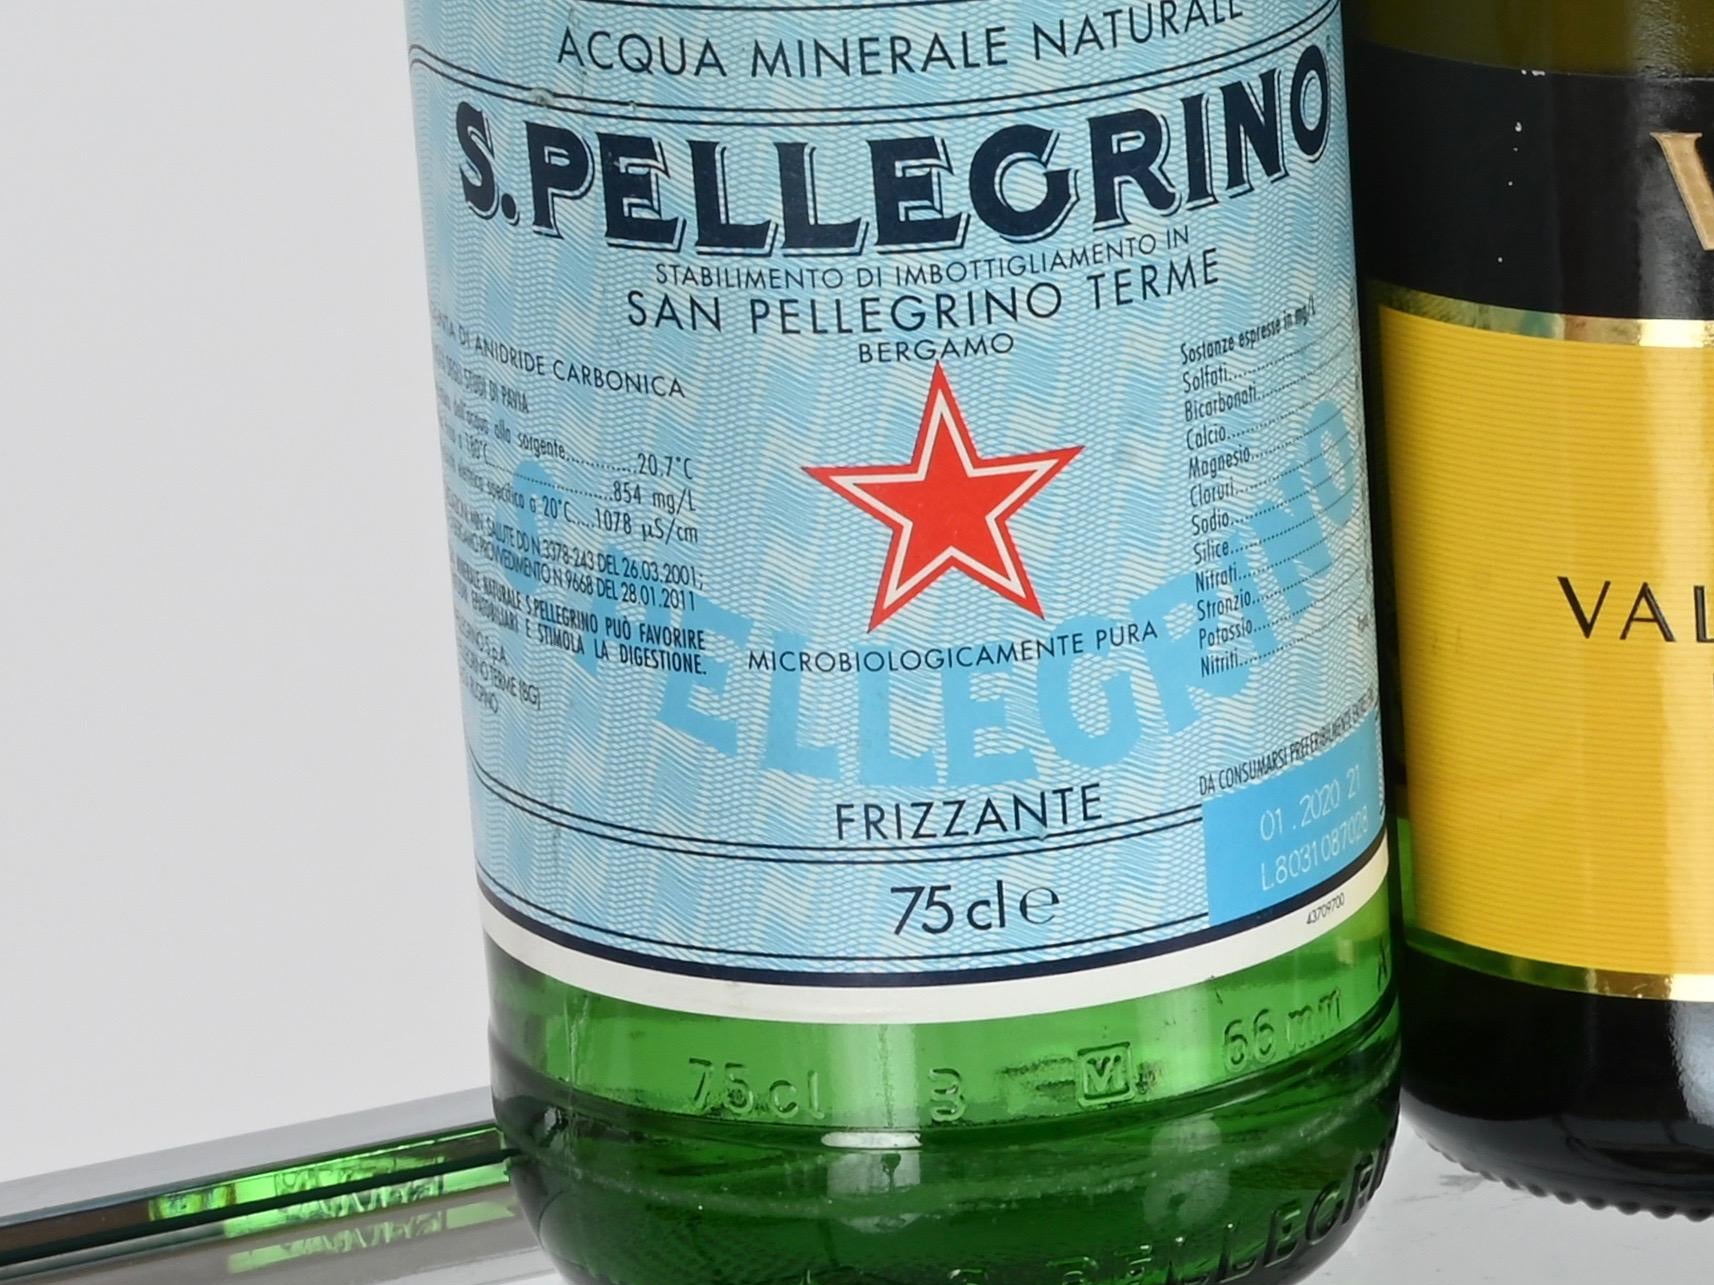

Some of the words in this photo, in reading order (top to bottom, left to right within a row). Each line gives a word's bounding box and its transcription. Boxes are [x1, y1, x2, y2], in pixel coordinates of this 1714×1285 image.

[557, 27, 727, 77] ACQUA
[751, 26, 1009, 78] MINERALE
[456, 44, 1332, 258] S.PELLEGRINO
[656, 263, 844, 290] STABILIMENTO
[858, 268, 882, 288] DI
[896, 234, 1157, 287] IMBOTTIGLIAMENTO
[1167, 226, 1190, 250] IN
[627, 290, 722, 333] SAN
[752, 281, 1063, 334] PELLEGRINO
[1087, 248, 1220, 309] TERME
[859, 333, 1015, 363] BERGAMO
[1180, 335, 1235, 365] Sostanze
[1238, 318, 1281, 349] espresse
[1283, 310, 1293, 330] in
[475, 336, 545, 376] ANIDRIDE
[553, 359, 686, 399] CARBONICA
[1183, 361, 1228, 394] Solfati
[1185, 380, 1258, 422] Bicarbonati
[1186, 423, 1227, 450] Calcio
[517, 432, 566, 459] sorgente
[638, 452, 693, 480] 20.7°C
[1189, 443, 1250, 479] Magnesio
[613, 480, 642, 505] 854
[652, 488, 696, 515] mg/L
[1189, 477, 1235, 508] Cloruri
[595, 507, 632, 535] 1078
[1191, 511, 1230, 536] Sodio
[597, 553, 619, 576] DEL
[1193, 537, 1230, 565] Silice
[565, 570, 593, 595] 9668
[596, 577, 618, 600] DEL
[621, 582, 695, 611] 28.01.2011
[1194, 562, 1238, 593] Nitrati
[1197, 589, 1251, 621] Stronzio
[538, 623, 585, 655] STIMOLA
[594, 638, 610, 661] LA
[619, 643, 707, 675] DIGESTIONE.
[605, 615, 631, 641] PUÒ
[639, 623, 707, 650] FAVORIRE
[748, 637, 1086, 673] MICROBIOLOGICAMENTE
[1095, 621, 1160, 651] PURA
[1199, 617, 1253, 649] Potassio
[1201, 647, 1239, 678] Nitriti
[1200, 776, 1216, 796] DA
[1218, 750, 1288, 791] CONSUMARSI
[836, 783, 1103, 841] FRIZZANTE
[1223, 1007, 1276, 1073] 66
